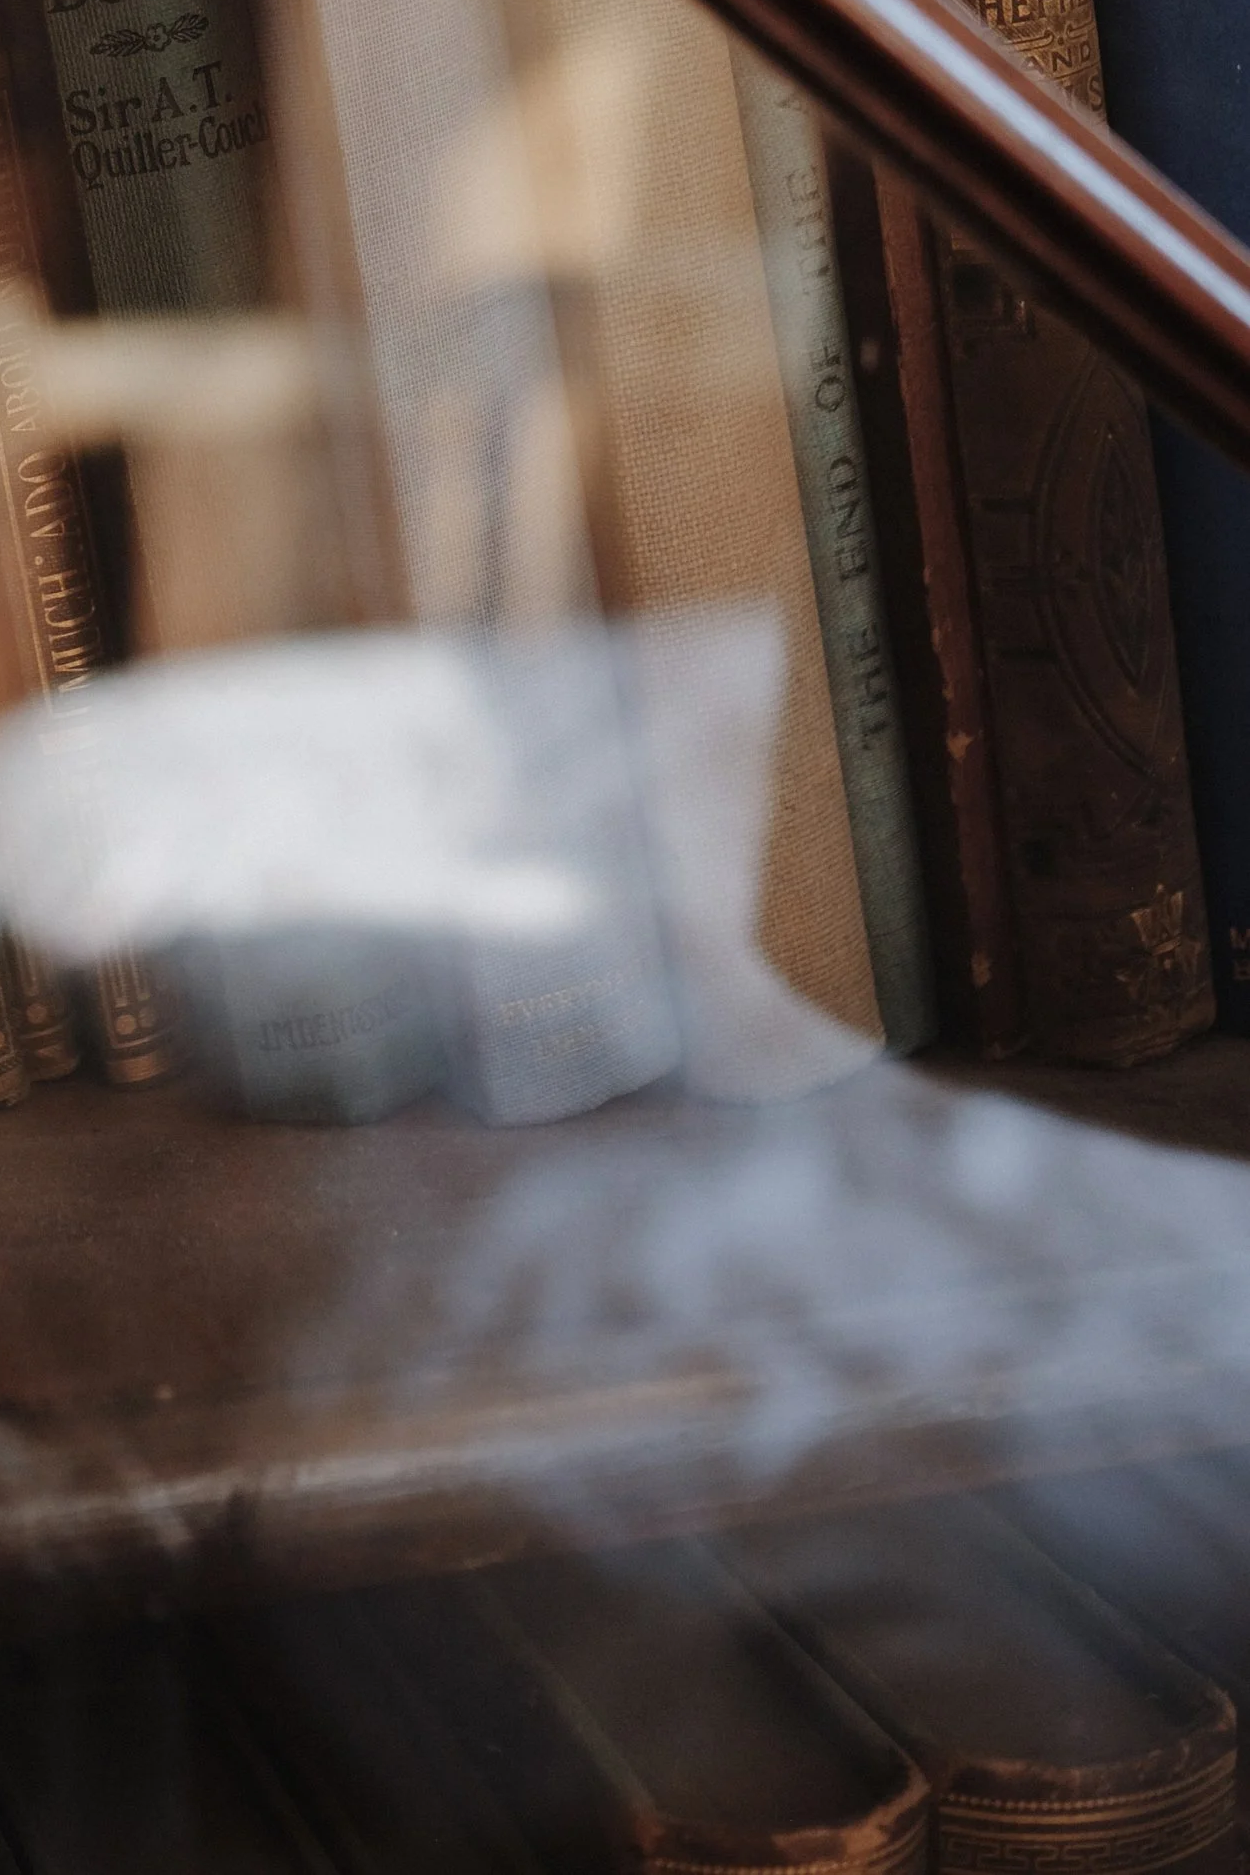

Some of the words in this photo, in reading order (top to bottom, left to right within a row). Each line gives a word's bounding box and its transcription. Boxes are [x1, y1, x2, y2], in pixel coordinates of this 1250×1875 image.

[63, 87, 144, 137] Sir
[813, 344, 846, 415] OF
[830, 453, 872, 588] END
[851, 617, 896, 753] THE
